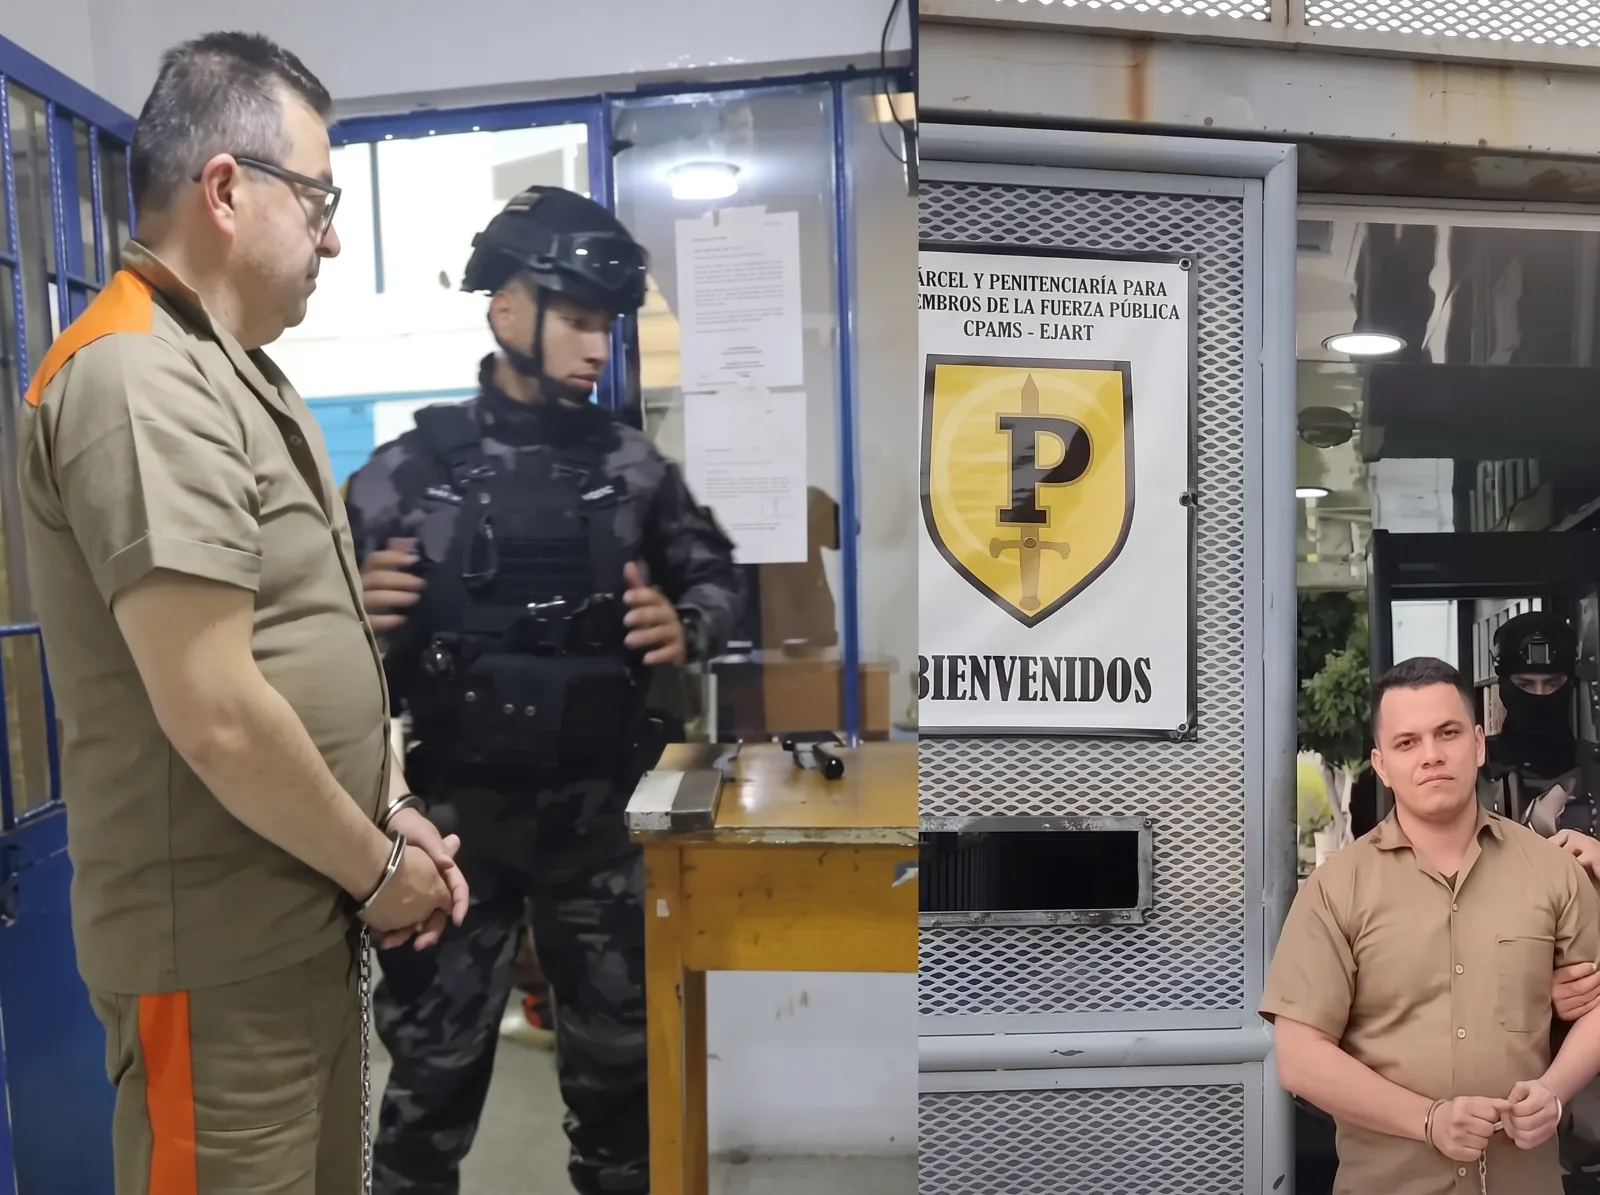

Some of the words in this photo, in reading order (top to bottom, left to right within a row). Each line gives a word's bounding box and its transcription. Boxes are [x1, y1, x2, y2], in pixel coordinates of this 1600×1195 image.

[973, 272, 985, 290] Y
[989, 273, 1118, 296] PENITENCIARÍA
[1123, 279, 1168, 297] PARA
[986, 296, 1010, 314] DE
[1013, 297, 1036, 315] LA
[1040, 299, 1105, 318] FUERZA
[1109, 298, 1180, 320] PÚBLICA
[963, 319, 1023, 339] CPAMS
[1039, 323, 1094, 341] EJART
[998, 415, 1092, 525] P
